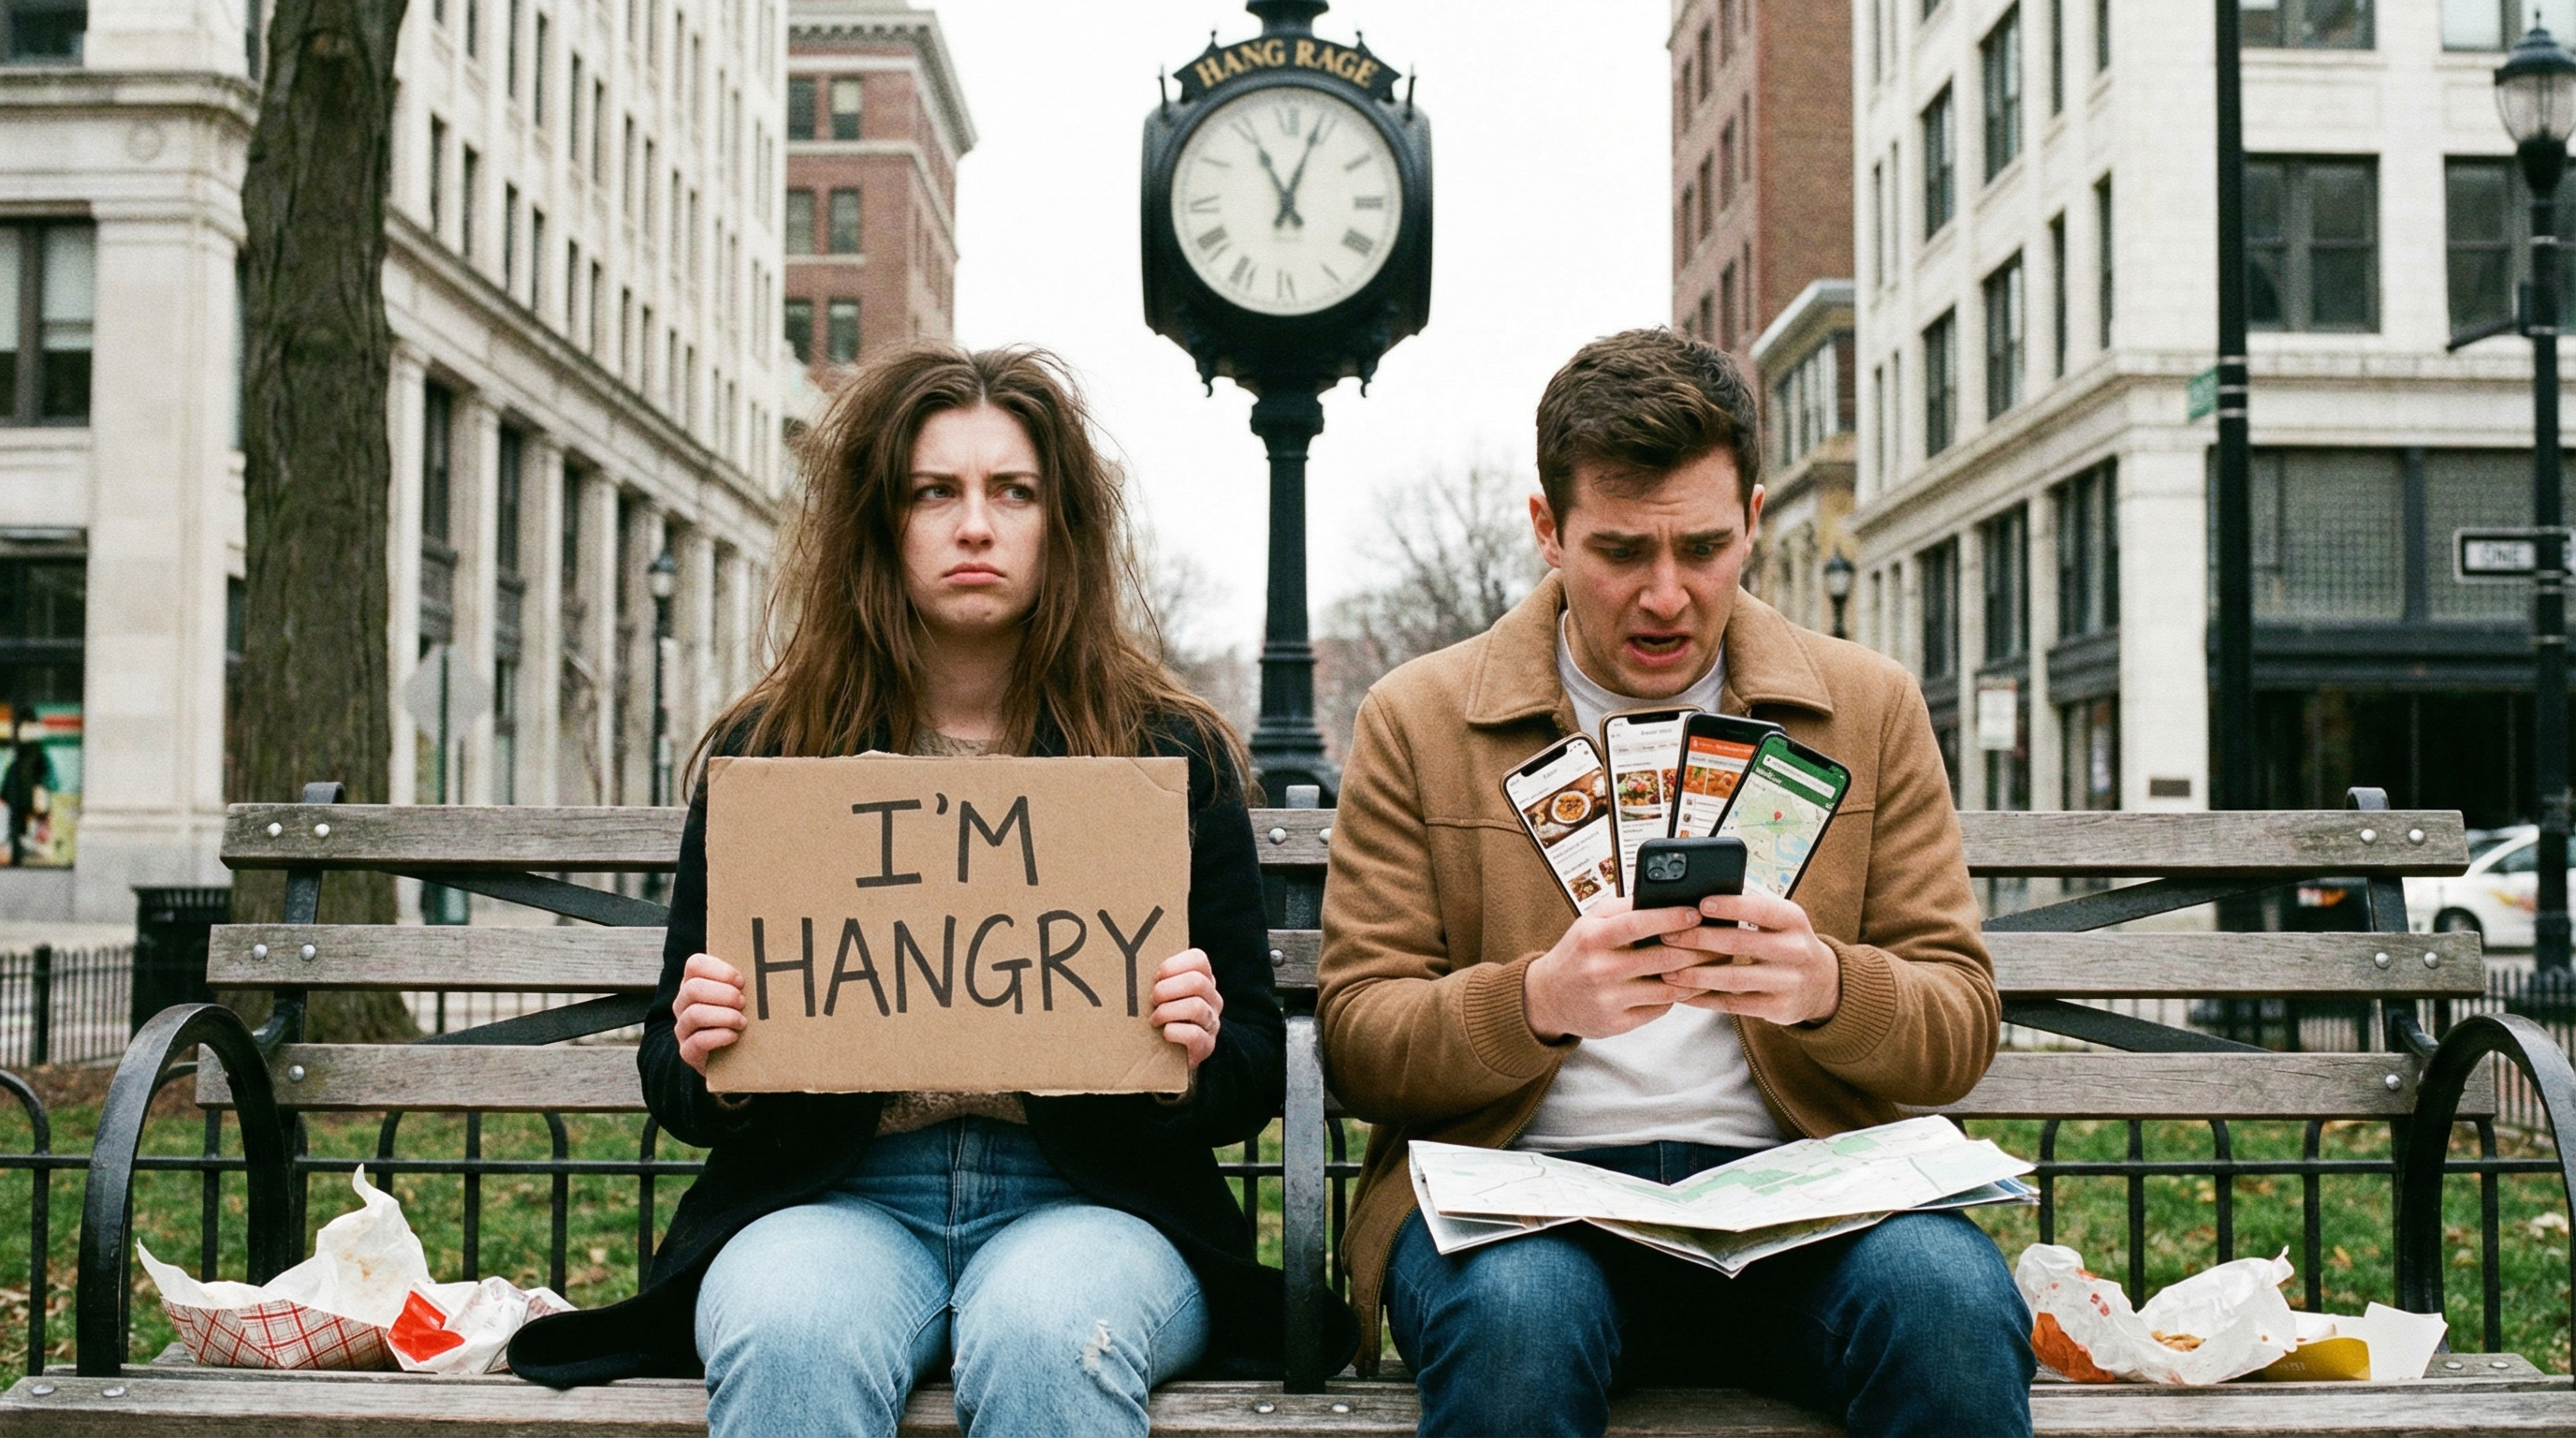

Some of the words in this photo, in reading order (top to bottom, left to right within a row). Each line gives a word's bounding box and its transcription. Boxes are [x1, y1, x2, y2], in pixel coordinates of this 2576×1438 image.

[1194, 38, 1286, 89] HANG
[1295, 38, 1380, 89] RAGE
[851, 792, 1039, 888] I'M
[752, 905, 1164, 1020] HANGRY
